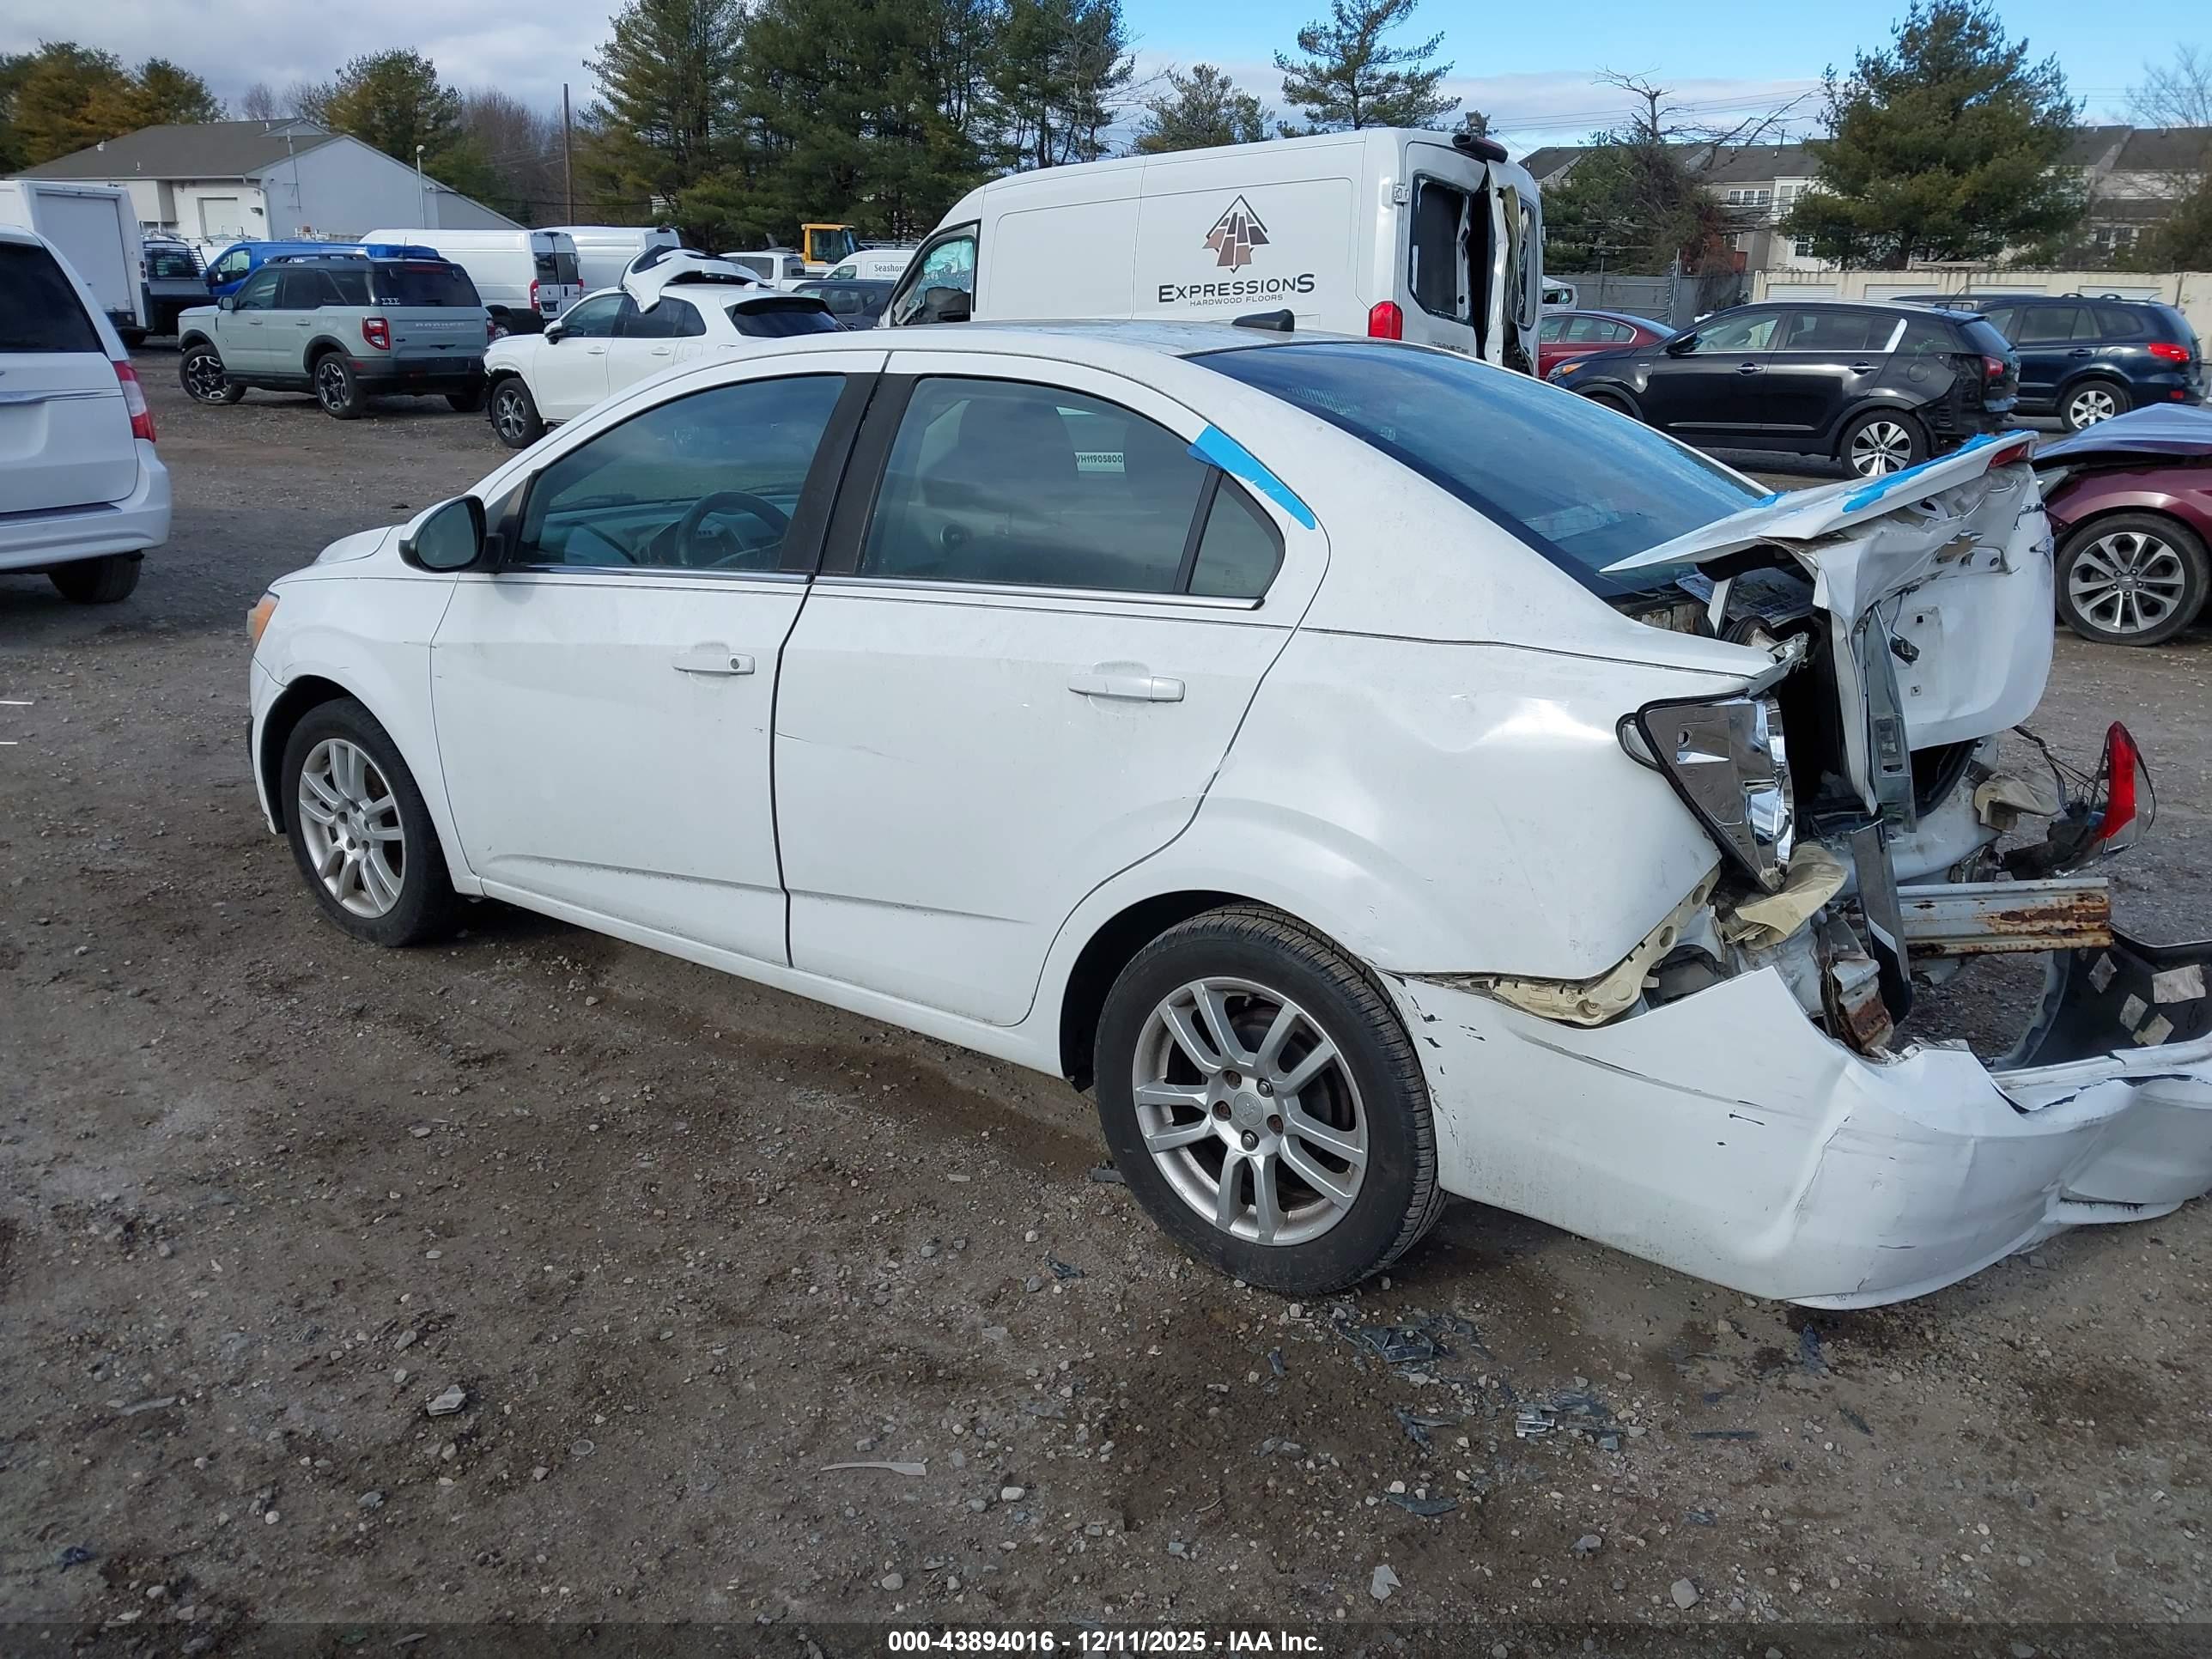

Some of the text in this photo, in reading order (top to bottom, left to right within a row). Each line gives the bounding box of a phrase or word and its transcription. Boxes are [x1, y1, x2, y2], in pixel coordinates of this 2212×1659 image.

[1158, 273, 1316, 303] EXPRESSIONS
[1189, 294, 1284, 307] HARDWOOD FLOORS
